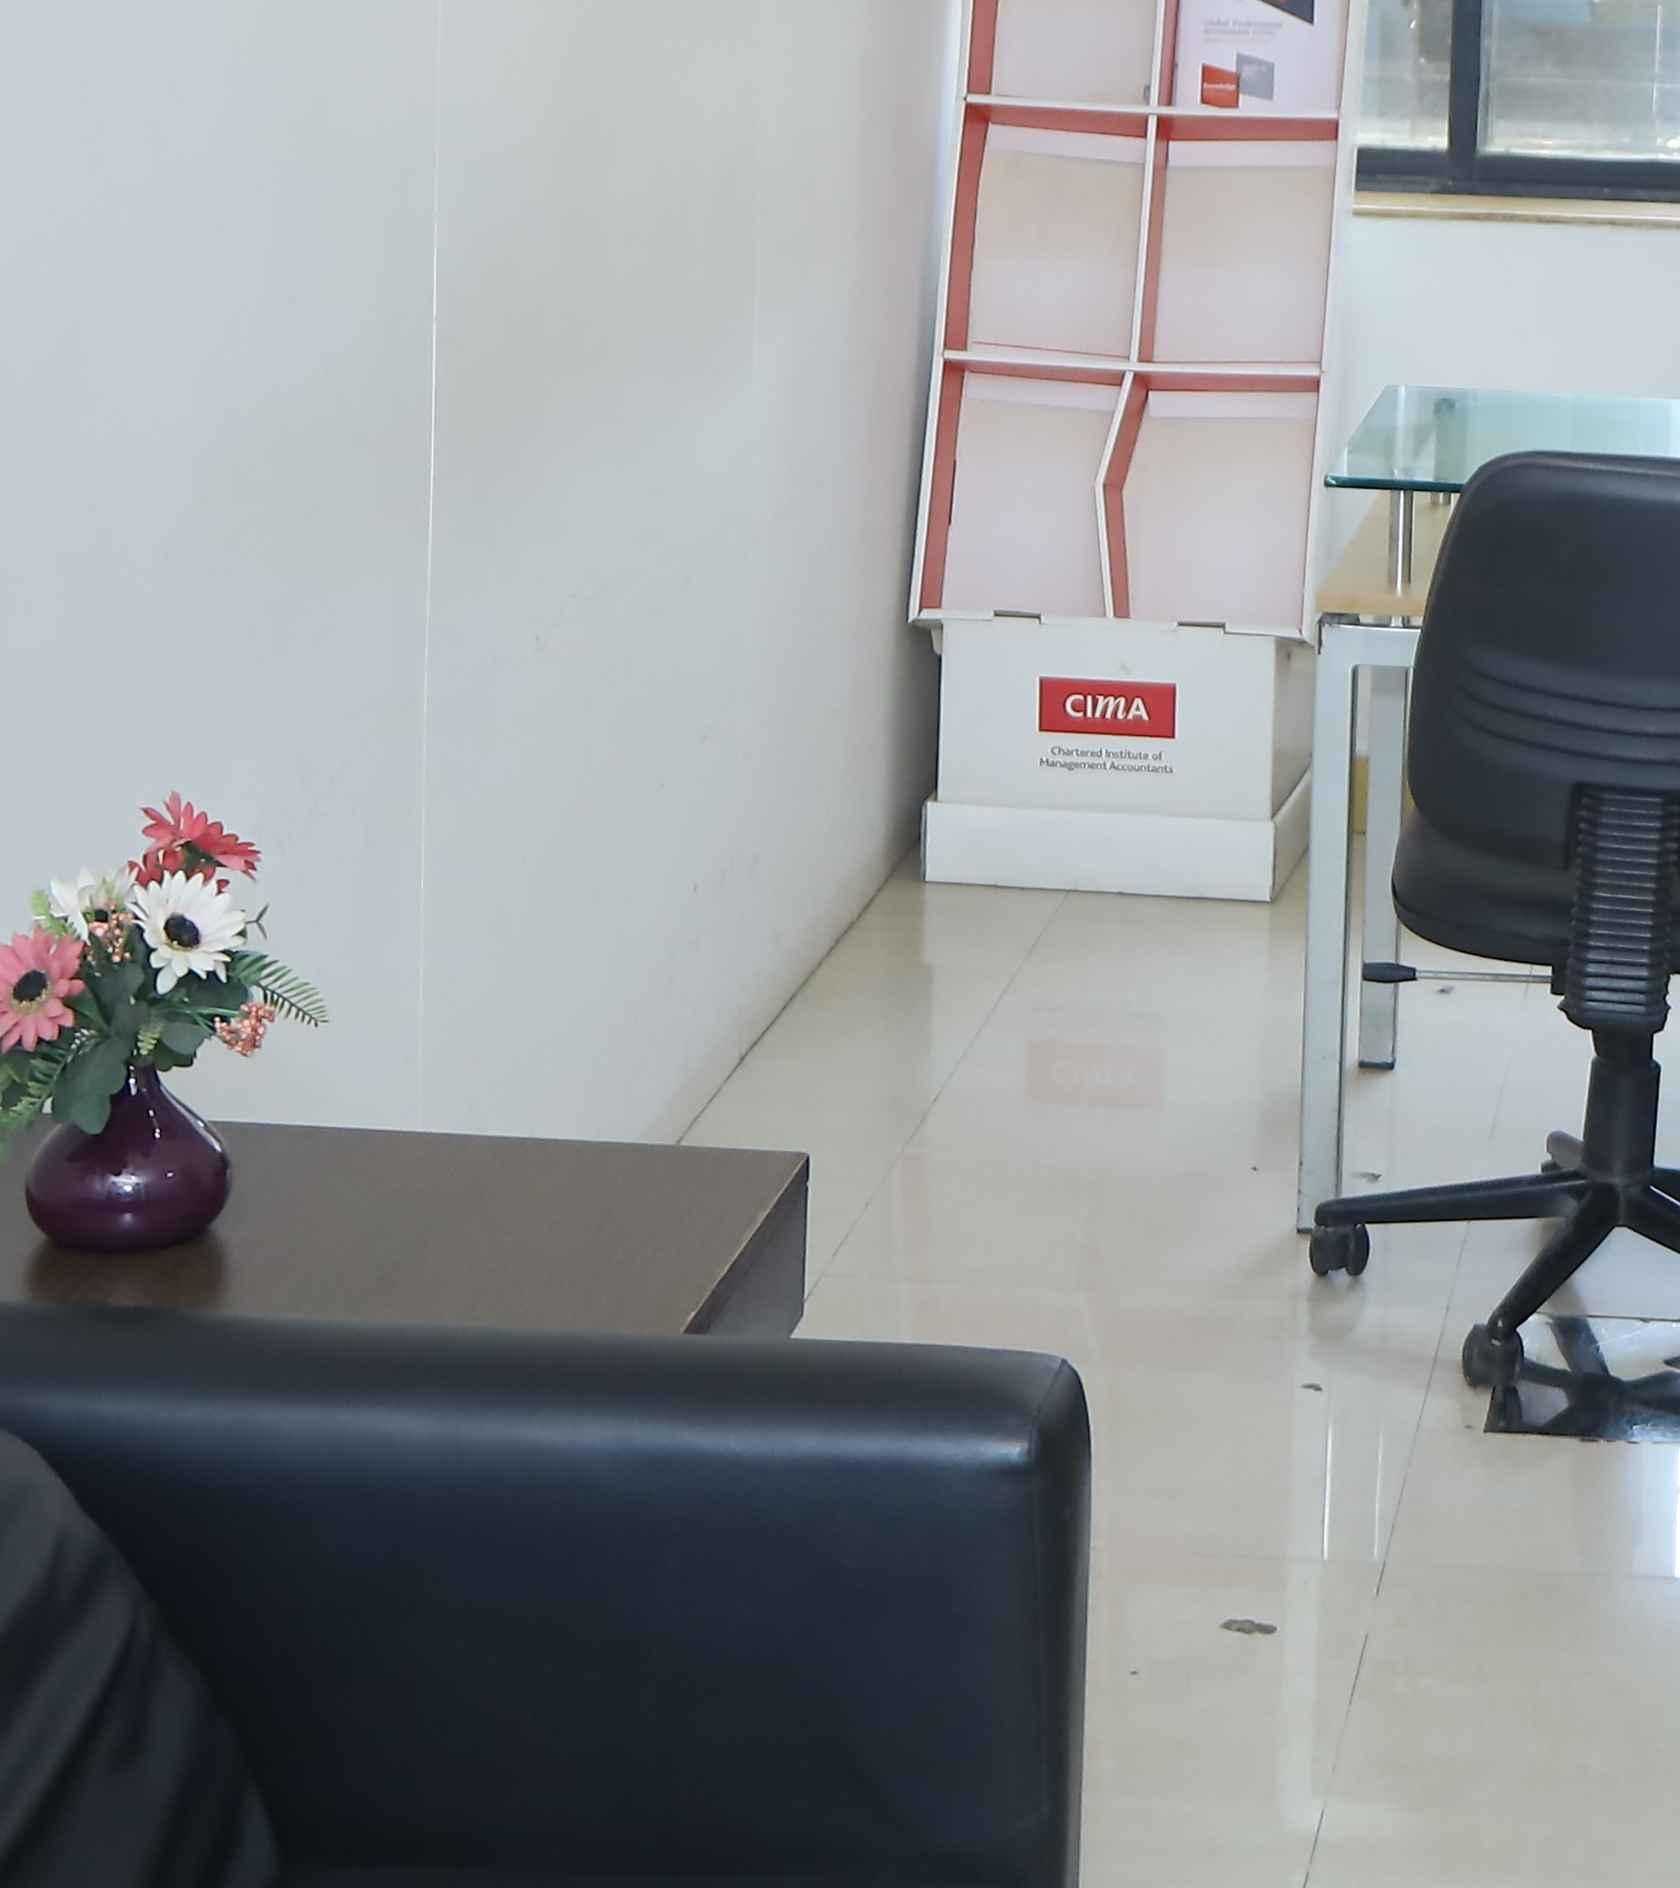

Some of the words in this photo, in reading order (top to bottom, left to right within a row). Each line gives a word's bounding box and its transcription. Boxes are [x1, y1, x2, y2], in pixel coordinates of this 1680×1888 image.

[1050, 744, 1103, 759] Chartered
[1105, 748, 1149, 761] Institute
[1152, 750, 1163, 762] of
[1039, 757, 1107, 771] Management
[1109, 760, 1174, 774] Accountants
